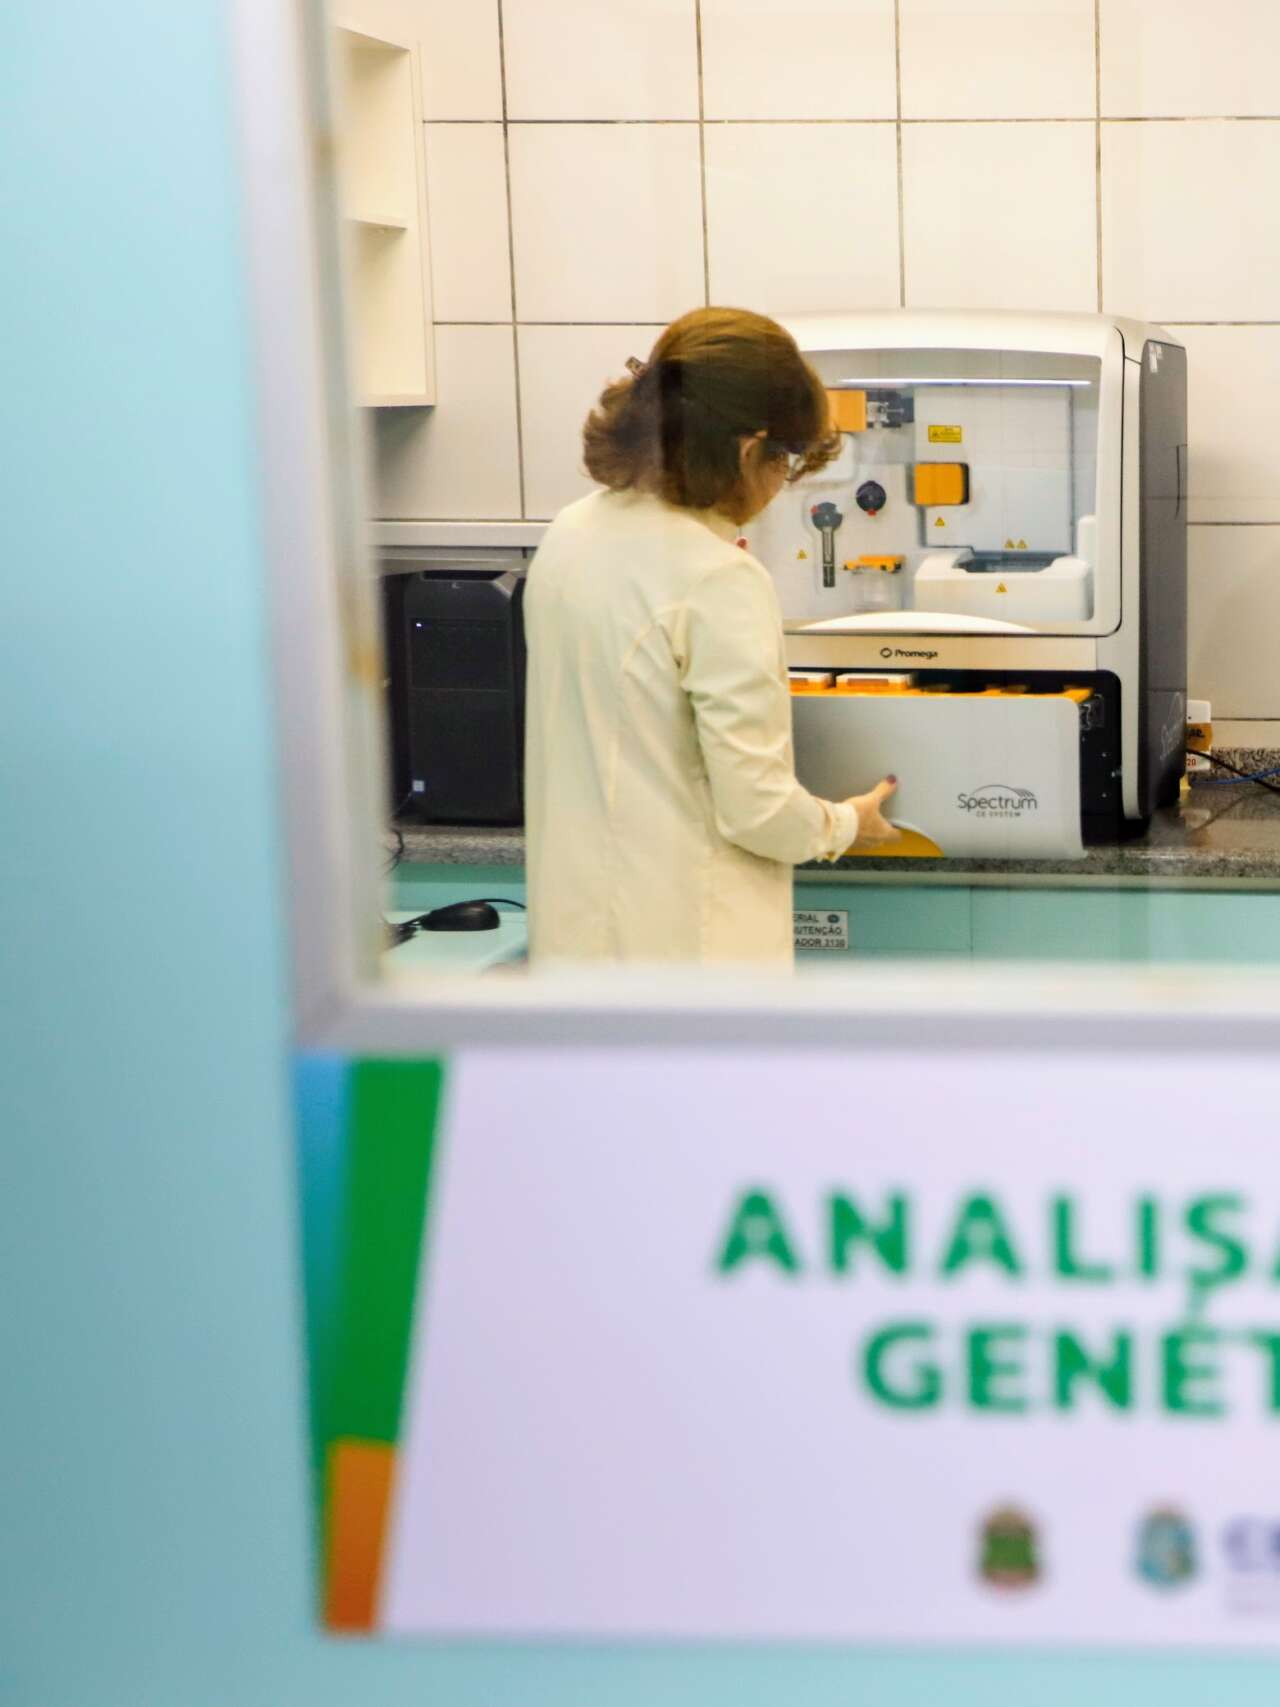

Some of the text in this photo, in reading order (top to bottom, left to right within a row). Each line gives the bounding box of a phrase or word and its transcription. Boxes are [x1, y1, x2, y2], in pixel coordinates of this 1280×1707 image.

[895, 648, 938, 660] Promega
[957, 794, 1037, 812] Spectrum
[795, 925, 842, 936] UTENÇÃO
